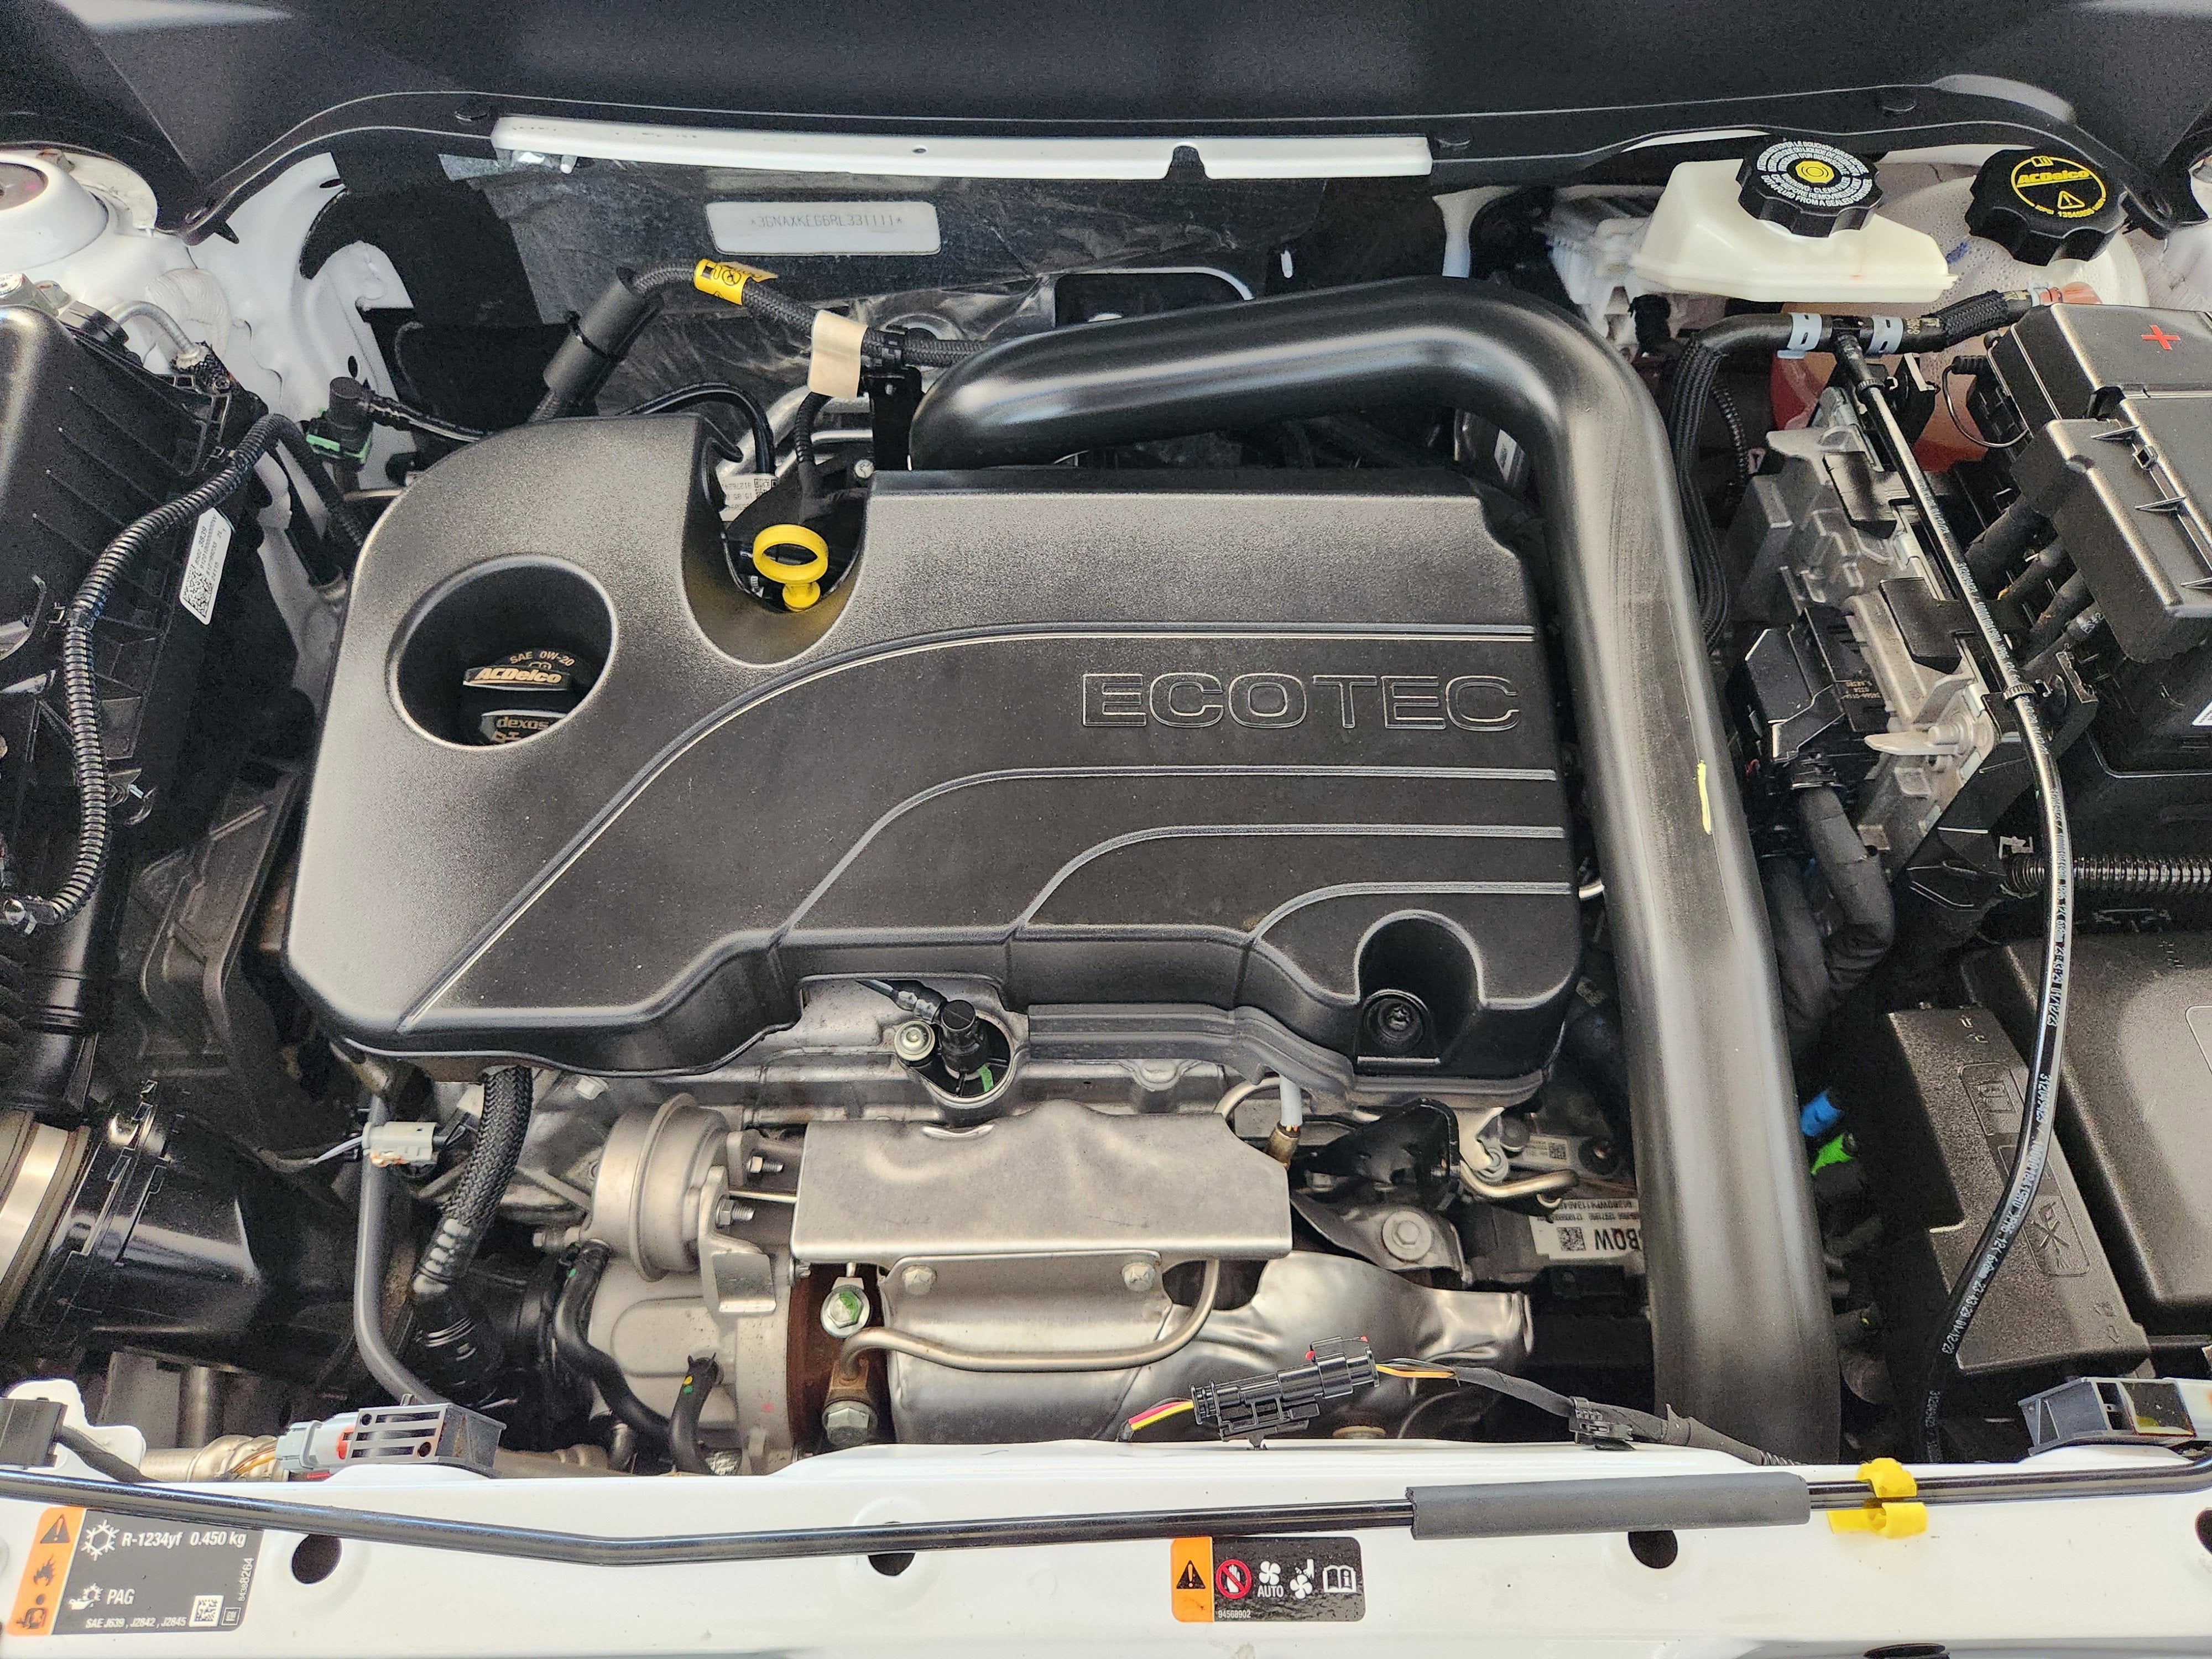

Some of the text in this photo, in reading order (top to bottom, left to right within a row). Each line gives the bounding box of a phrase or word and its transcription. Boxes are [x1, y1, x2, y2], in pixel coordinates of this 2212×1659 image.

[1801, 147, 1827, 155] LIQUIDE
[1813, 153, 1833, 163] BIDON
[2017, 170, 2090, 184] ACDelco
[1770, 174, 1786, 185] CAP
[1778, 182, 1809, 198] BEFORE
[1813, 186, 1840, 194] CLEAN
[1772, 186, 1796, 200] FLUID
[1793, 195, 1818, 206] FROM
[1825, 197, 1855, 206] SEALED
[199, 526, 207, 546] 3839
[510, 650, 576, 666] SAE 0W-20
[474, 667, 562, 684] ACDelco
[1082, 671, 1520, 732] ECOTEC
[497, 716, 549, 731] dexos
[2034, 1072, 2052, 1125] 312049423
[1957, 1279, 1986, 1319] 23:43:29
[1939, 1317, 1968, 1356] 01/12/23
[121, 1531, 247, 1549] R-1234yf 0.450 kg
[238, 1557, 254, 1602] 84388264
[107, 1589, 135, 1605] PAG
[1257, 1584, 1284, 1598] AUTO
[1218, 1609, 1251, 1619] 94568902
[85, 1618, 104, 1629] SAE
[161, 1616, 187, 1627] J2845
